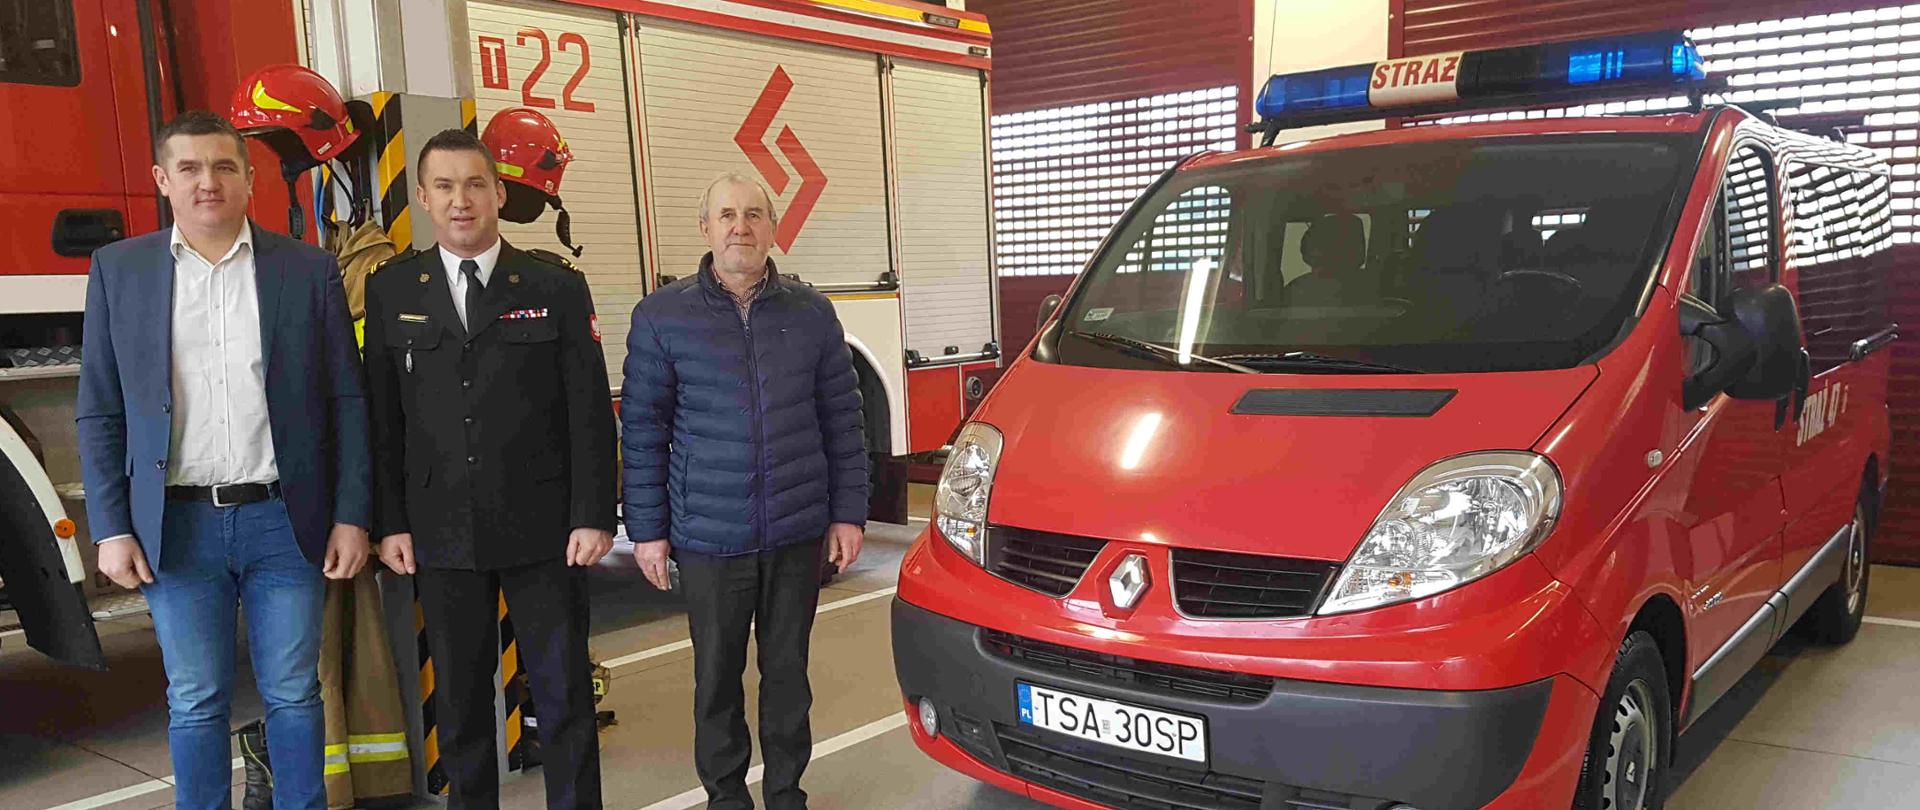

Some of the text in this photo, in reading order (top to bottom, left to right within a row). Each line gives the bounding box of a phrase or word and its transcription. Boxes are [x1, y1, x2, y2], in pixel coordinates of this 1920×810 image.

[481, 27, 595, 112] T 22
[1021, 708, 1032, 719] PL
[1037, 691, 1198, 755] TSA 30SP
